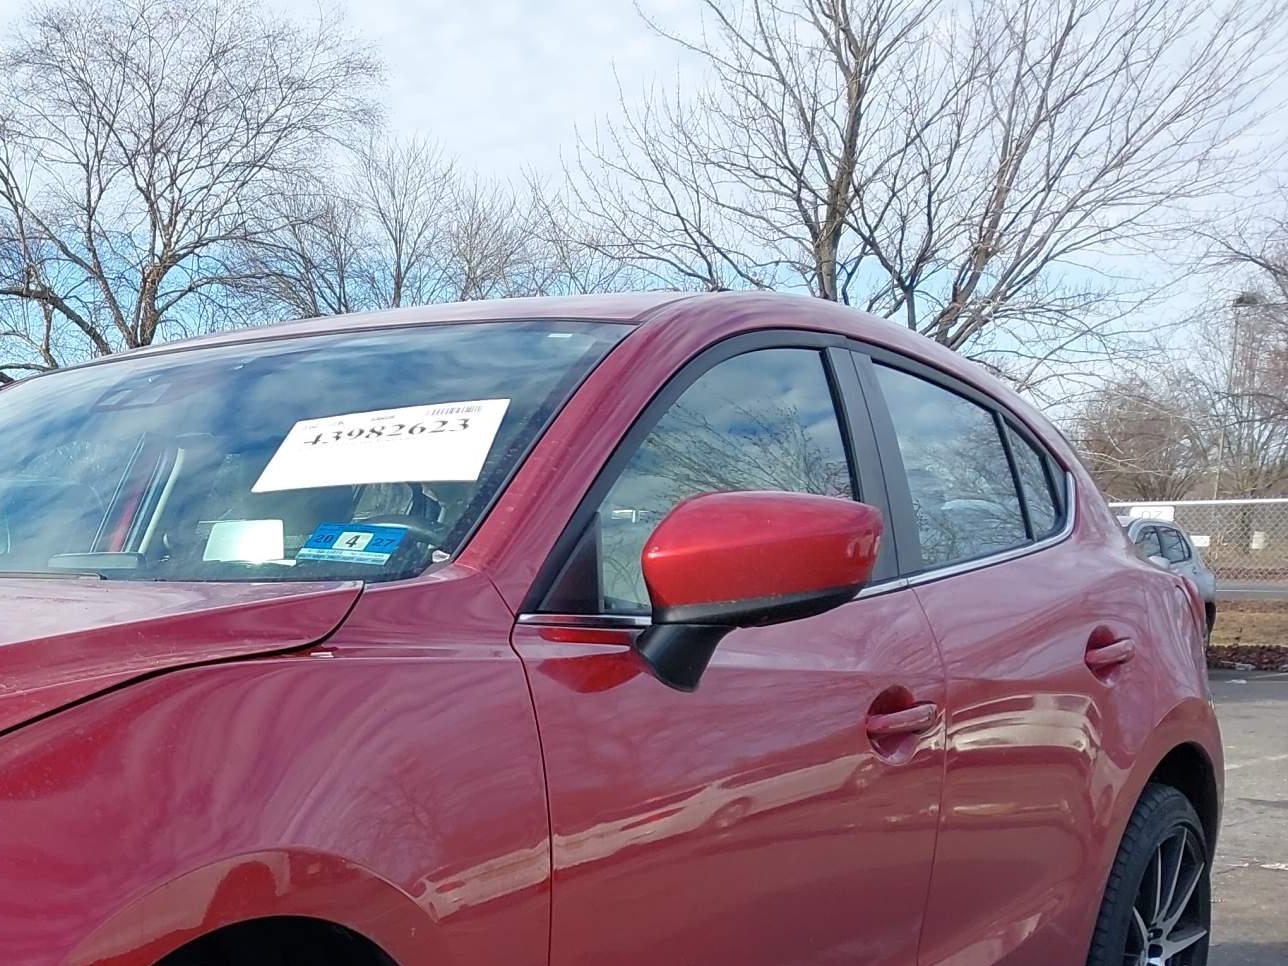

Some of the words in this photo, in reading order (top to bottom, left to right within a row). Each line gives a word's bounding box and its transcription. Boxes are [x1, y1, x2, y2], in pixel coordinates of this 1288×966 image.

[303, 418, 470, 445] 43982623
[313, 534, 334, 544] 20
[345, 534, 361, 548] 4
[371, 537, 396, 547] 27
